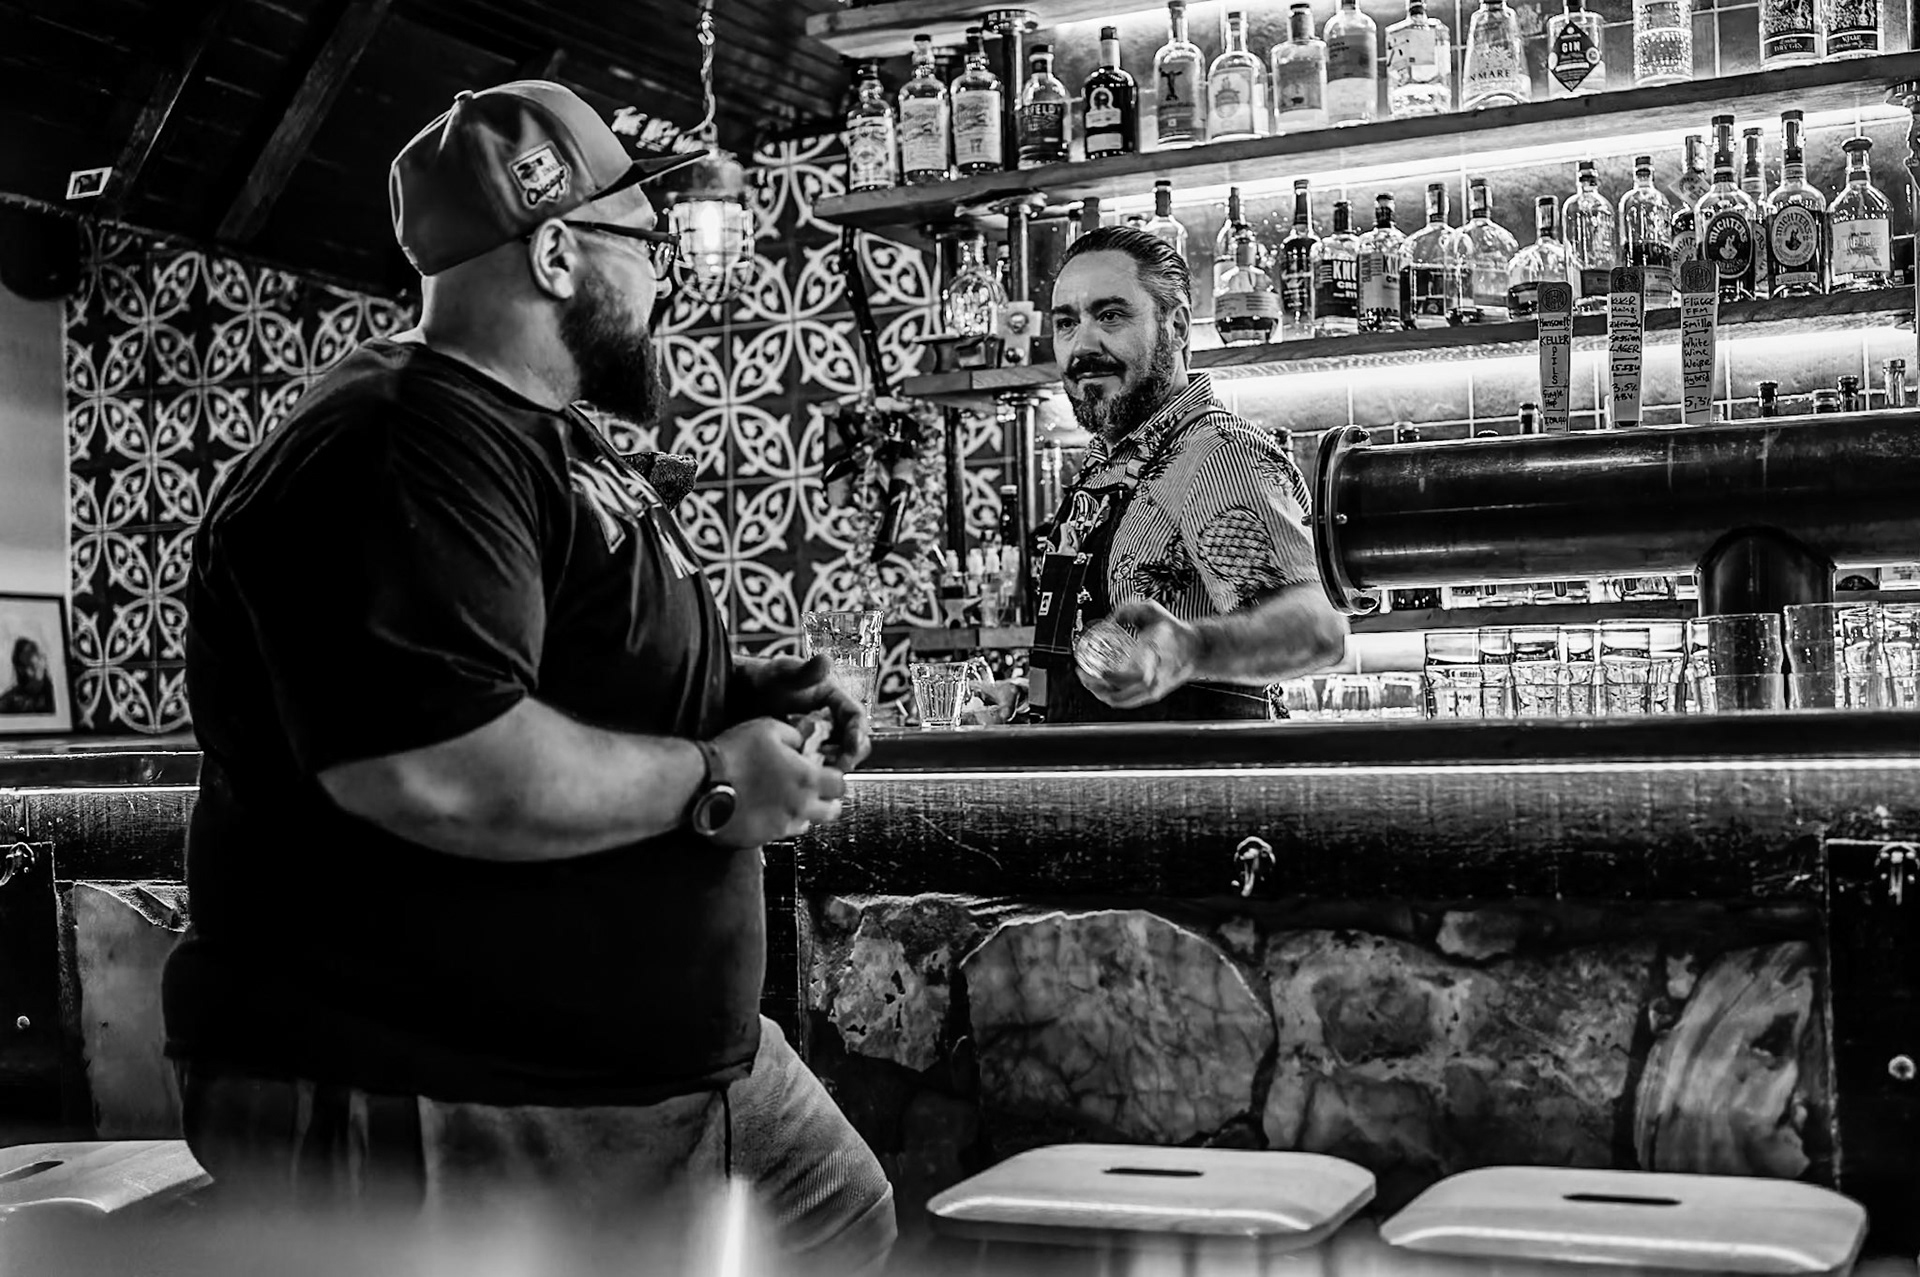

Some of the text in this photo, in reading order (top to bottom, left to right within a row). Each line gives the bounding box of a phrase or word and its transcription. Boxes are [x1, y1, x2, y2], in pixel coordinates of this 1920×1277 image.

[1561, 41, 1581, 53] GIN
[1685, 308, 1708, 316] FFM
[1682, 317, 1713, 329] Smilla
[1540, 335, 1570, 347] KELLER
[1683, 337, 1709, 349] White
[1608, 343, 1641, 353] LAGER
[1684, 373, 1710, 386] Hybrid
